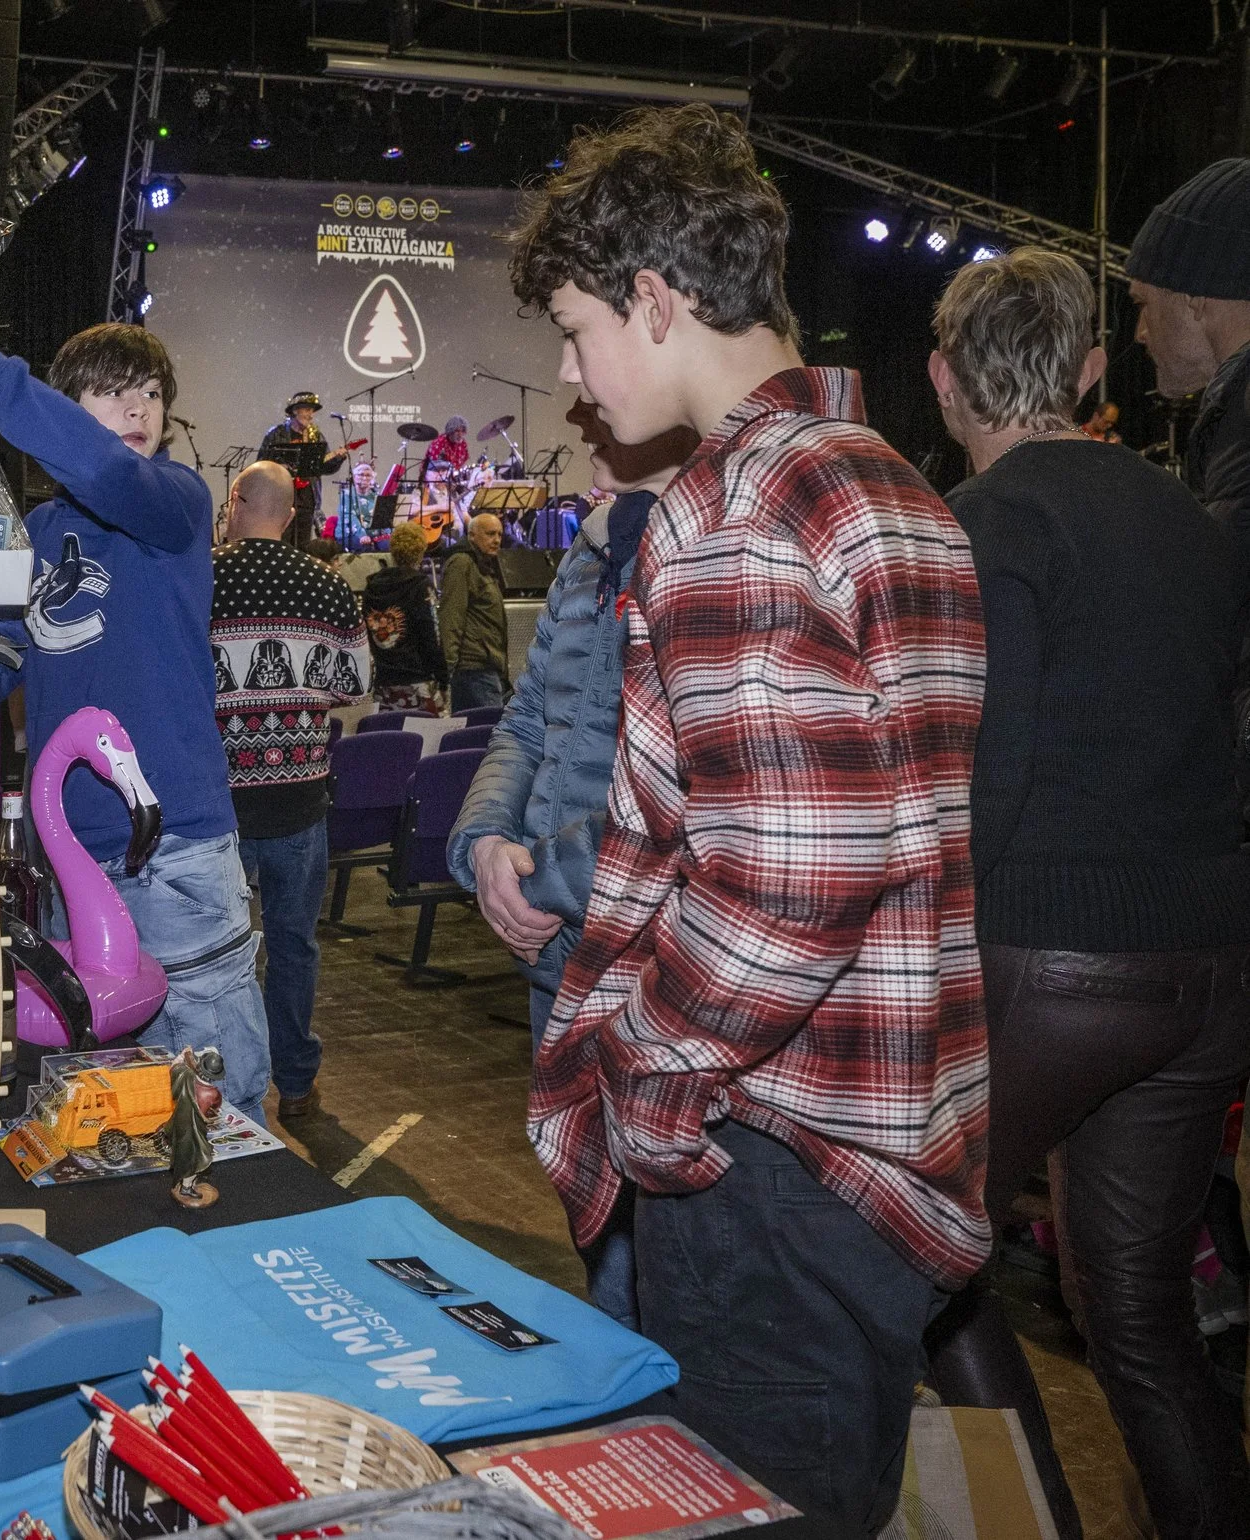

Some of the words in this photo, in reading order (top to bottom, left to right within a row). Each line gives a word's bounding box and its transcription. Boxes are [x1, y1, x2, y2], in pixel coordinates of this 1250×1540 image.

[317, 224, 325, 235] A
[326, 225, 352, 236] ROCK
[354, 227, 407, 239] COLLECTIVE
[317, 235, 454, 257] WINTEXTRAVAGANZA
[349, 414, 361, 422] THE
[387, 404, 421, 414] DECEMBER
[289, 1246, 364, 1305] INSTITUTE
[252, 1248, 386, 1355] MISFITS
[353, 1306, 412, 1348] MUSIC
[94, 1440, 106, 1486] MISFITS
[511, 1454, 548, 1486] Merch
[543, 1470, 568, 1490] List
[544, 1484, 603, 1539] Christmas
[565, 1489, 598, 1517] Price
